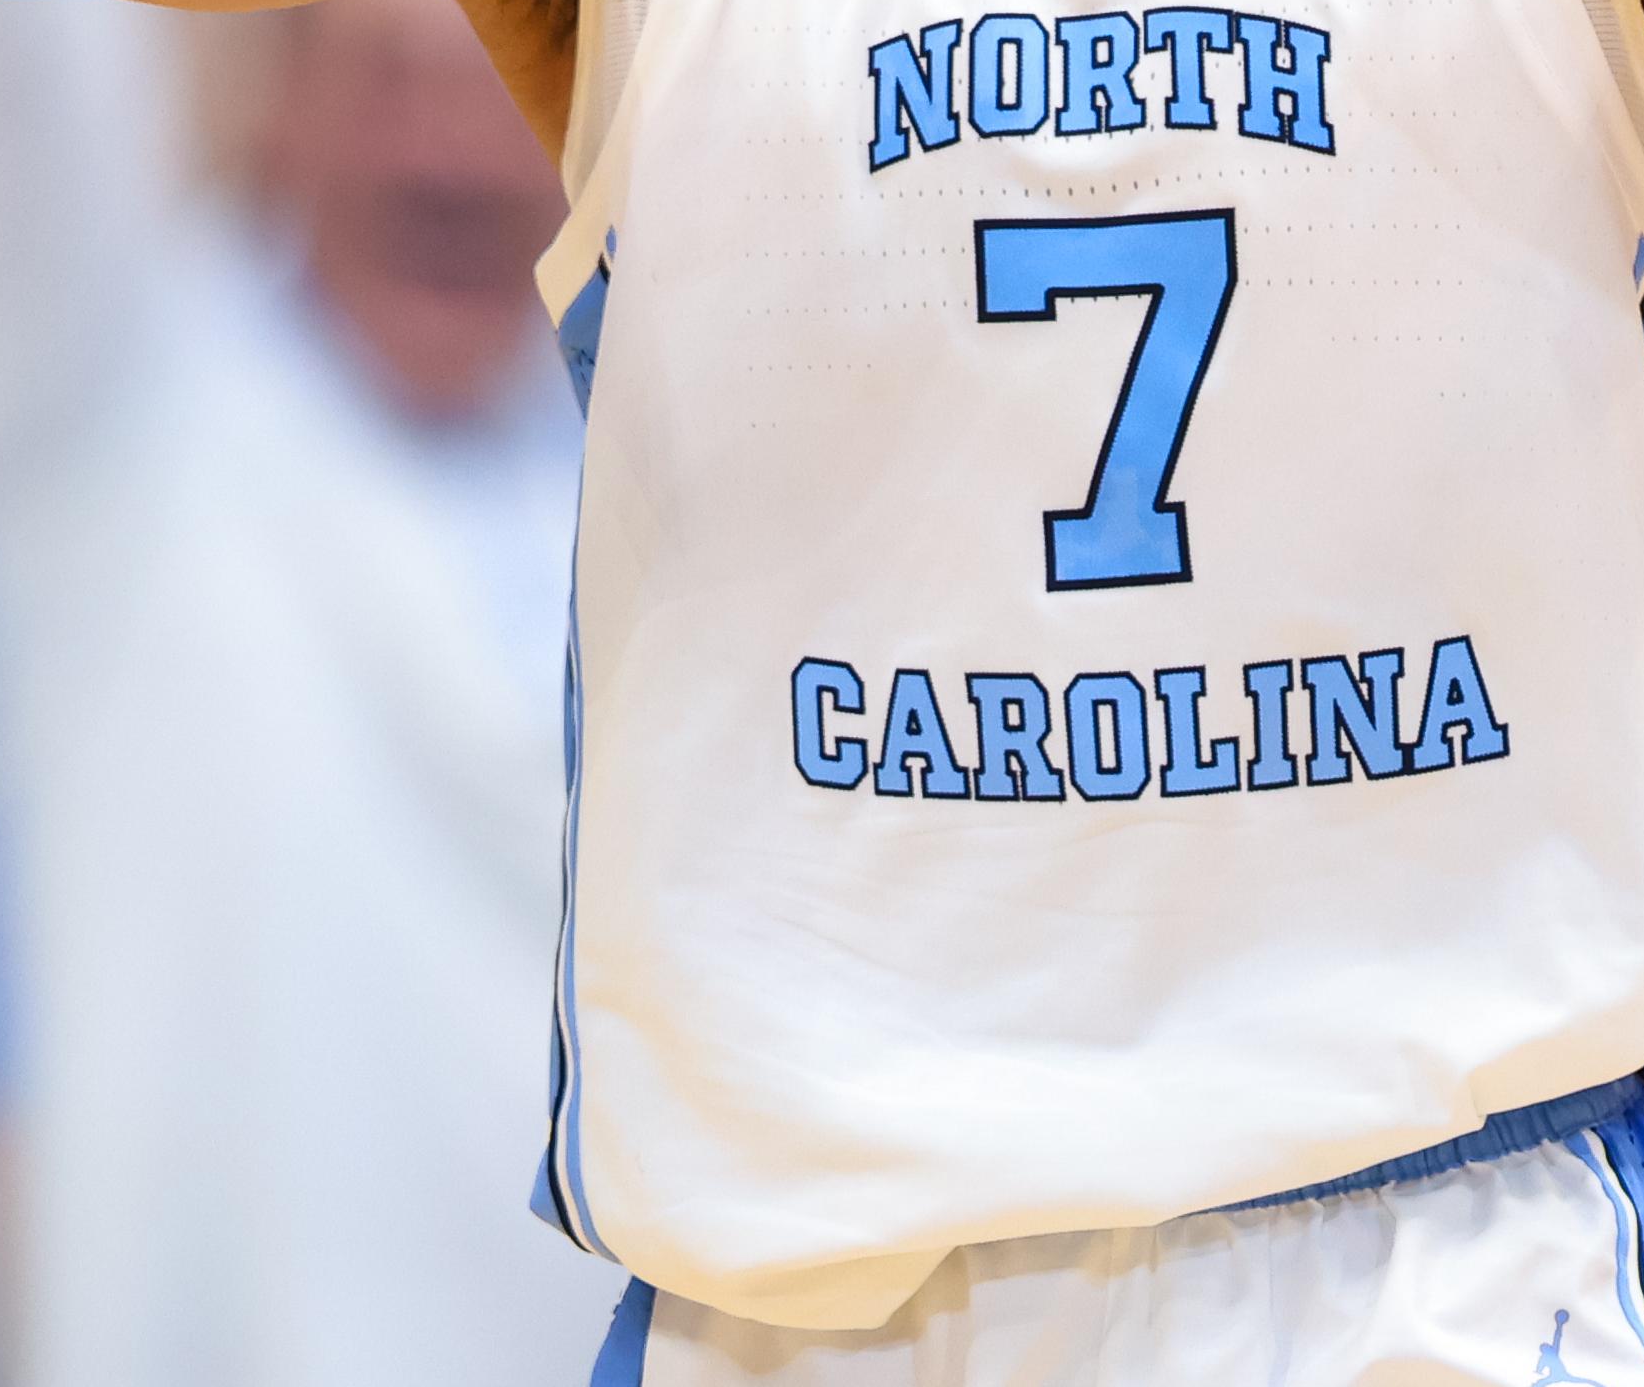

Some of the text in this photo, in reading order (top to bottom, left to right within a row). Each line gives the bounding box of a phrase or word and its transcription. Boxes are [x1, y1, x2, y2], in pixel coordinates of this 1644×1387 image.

[868, 5, 1337, 174] NORTH
[973, 207, 1239, 593] 7
[791, 634, 1510, 803] CAROLINA
